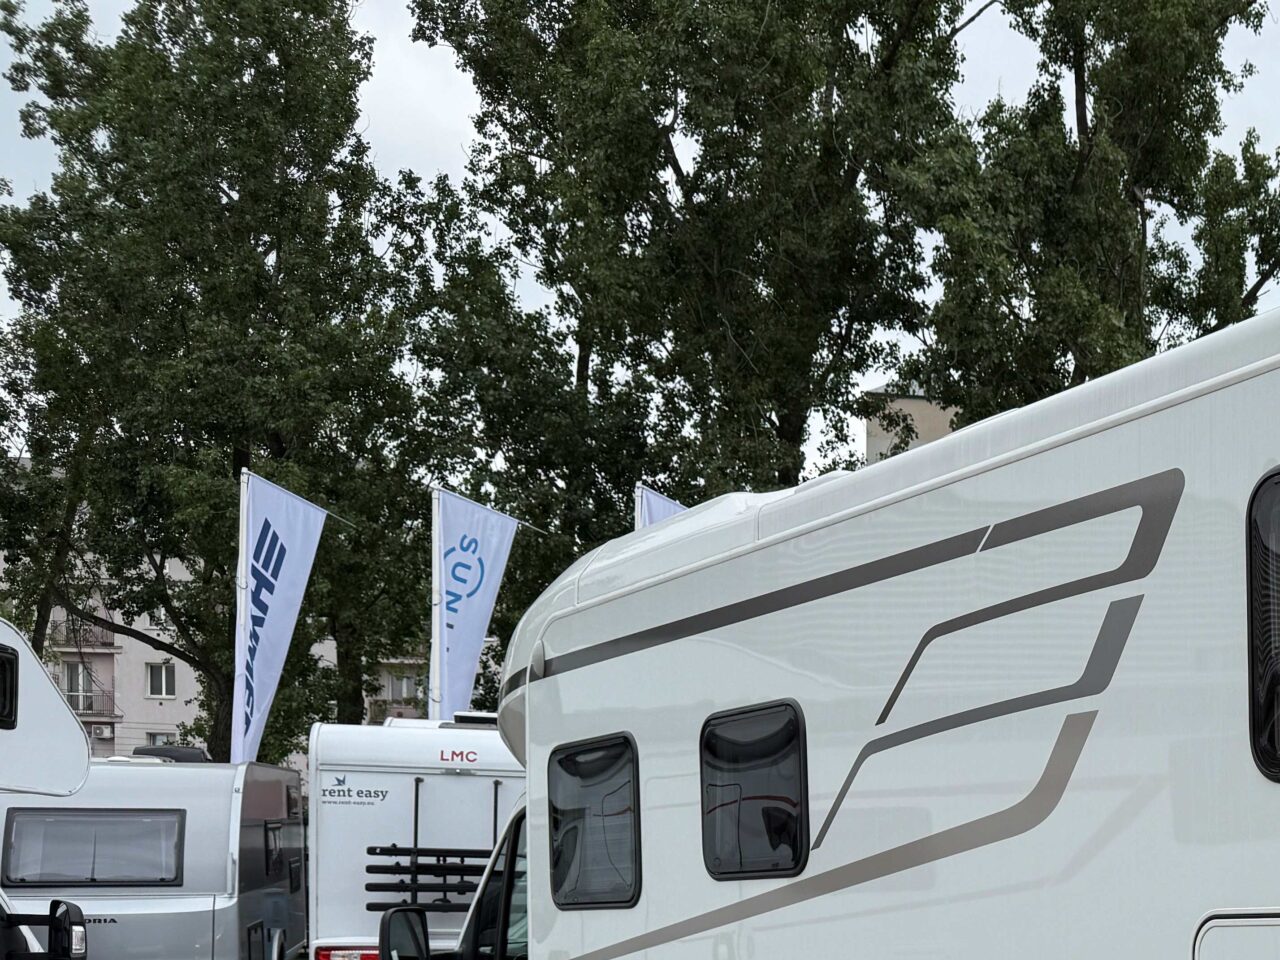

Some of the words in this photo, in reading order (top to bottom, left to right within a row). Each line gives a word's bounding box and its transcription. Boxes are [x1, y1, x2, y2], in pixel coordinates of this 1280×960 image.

[439, 750, 478, 763] LMC
[321, 786, 353, 798] rent
[356, 788, 389, 802] easy
